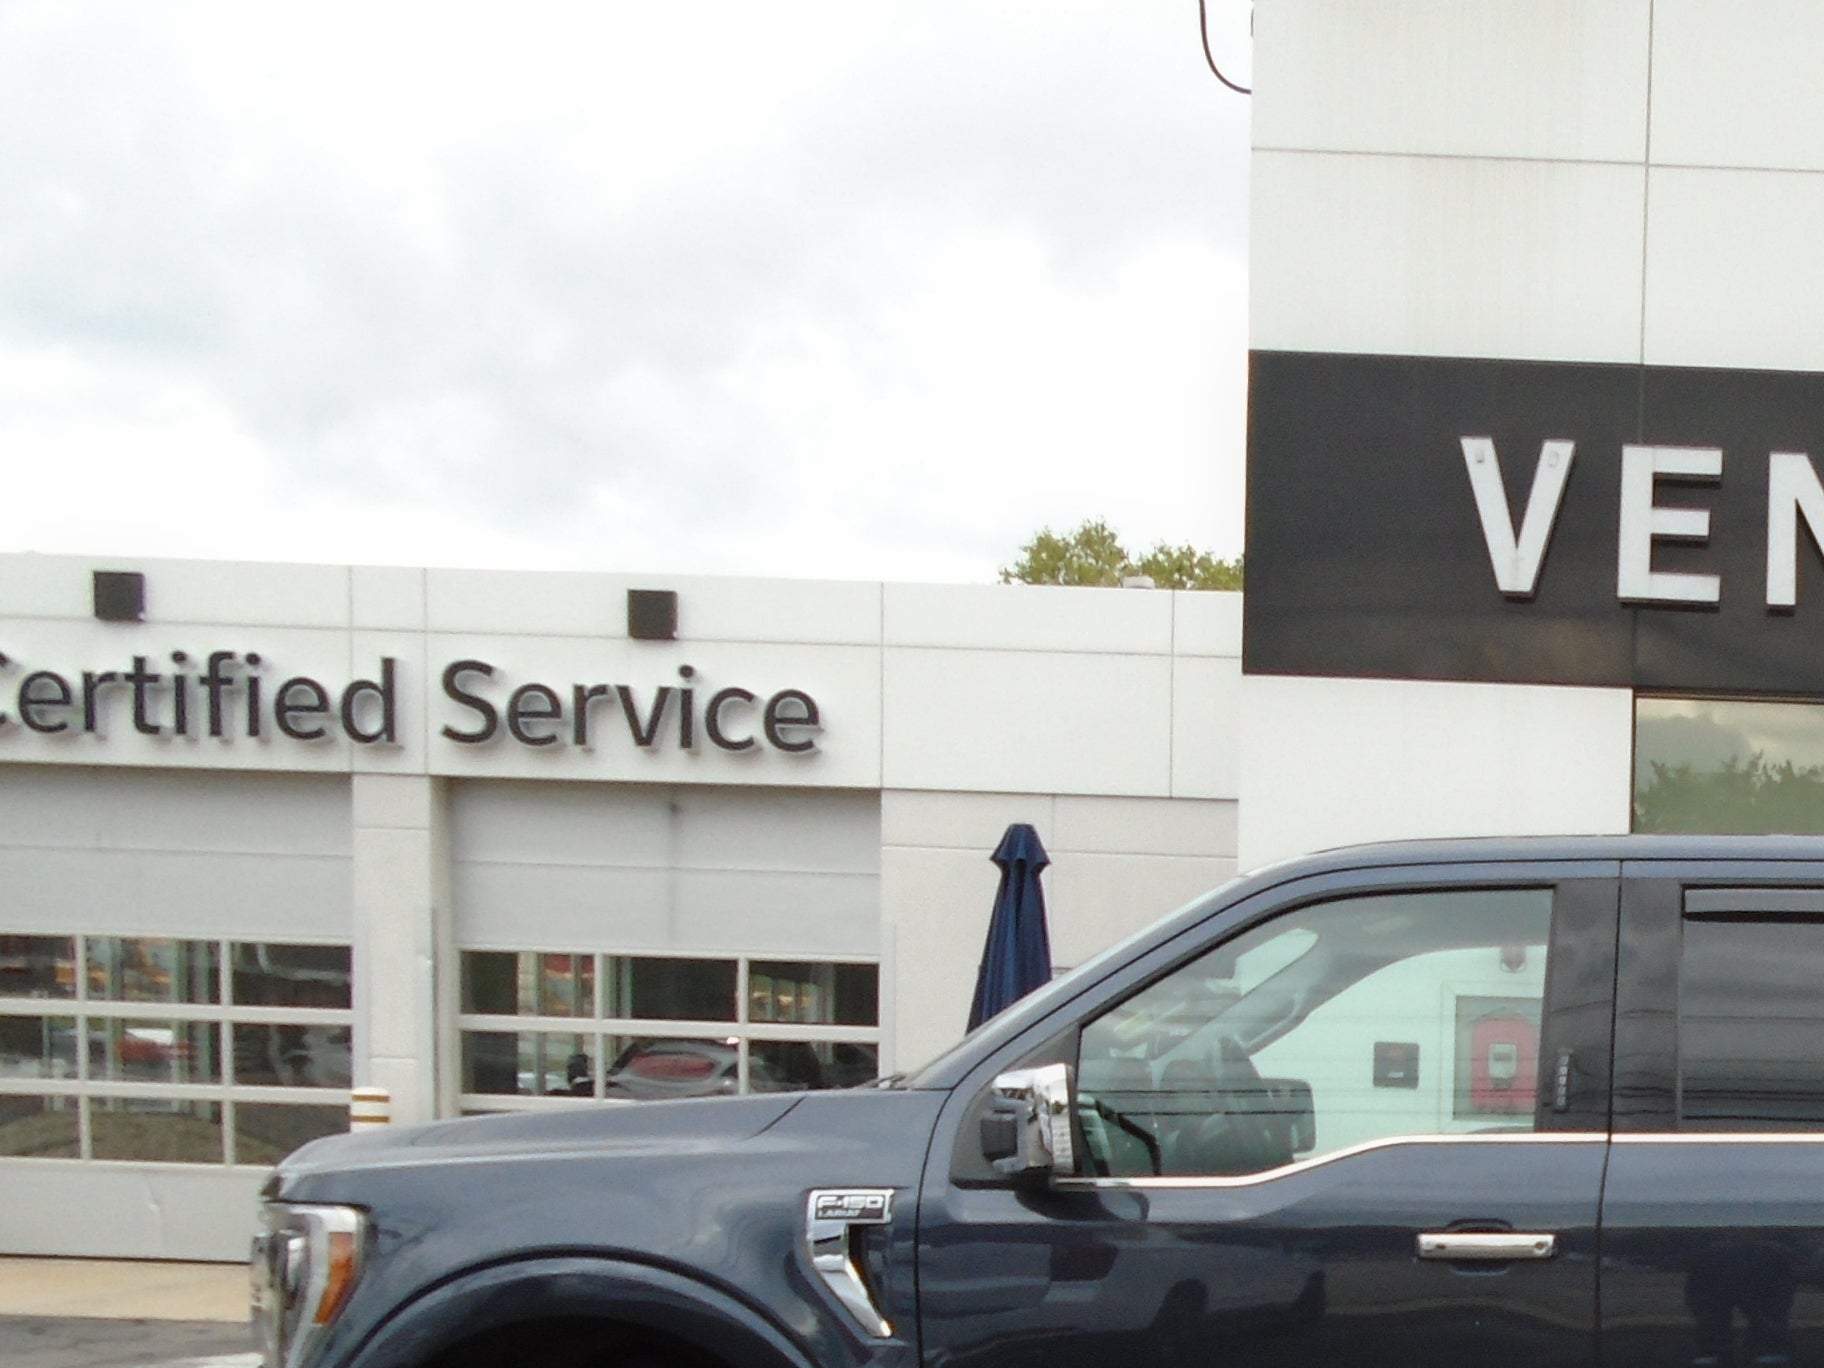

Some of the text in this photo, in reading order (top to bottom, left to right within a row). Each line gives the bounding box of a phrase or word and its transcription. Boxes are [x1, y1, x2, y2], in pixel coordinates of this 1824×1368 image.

[0, 649, 822, 753] ertified Service
[817, 1195, 884, 1209] F-150
